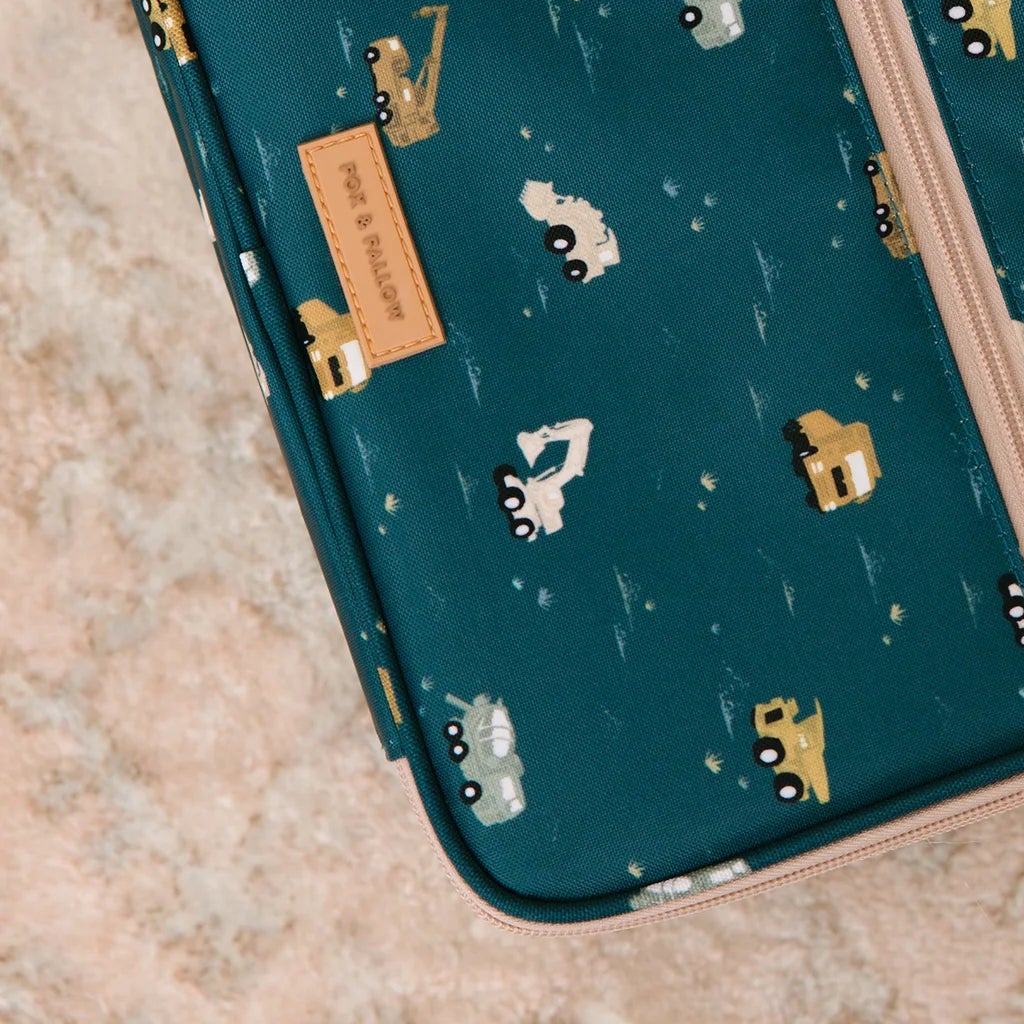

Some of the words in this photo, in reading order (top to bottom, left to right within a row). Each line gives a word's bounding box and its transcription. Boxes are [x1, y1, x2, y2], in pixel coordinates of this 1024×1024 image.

[339, 160, 367, 209] FOX
[354, 213, 373, 231] &
[362, 232, 405, 322] FALLOW
